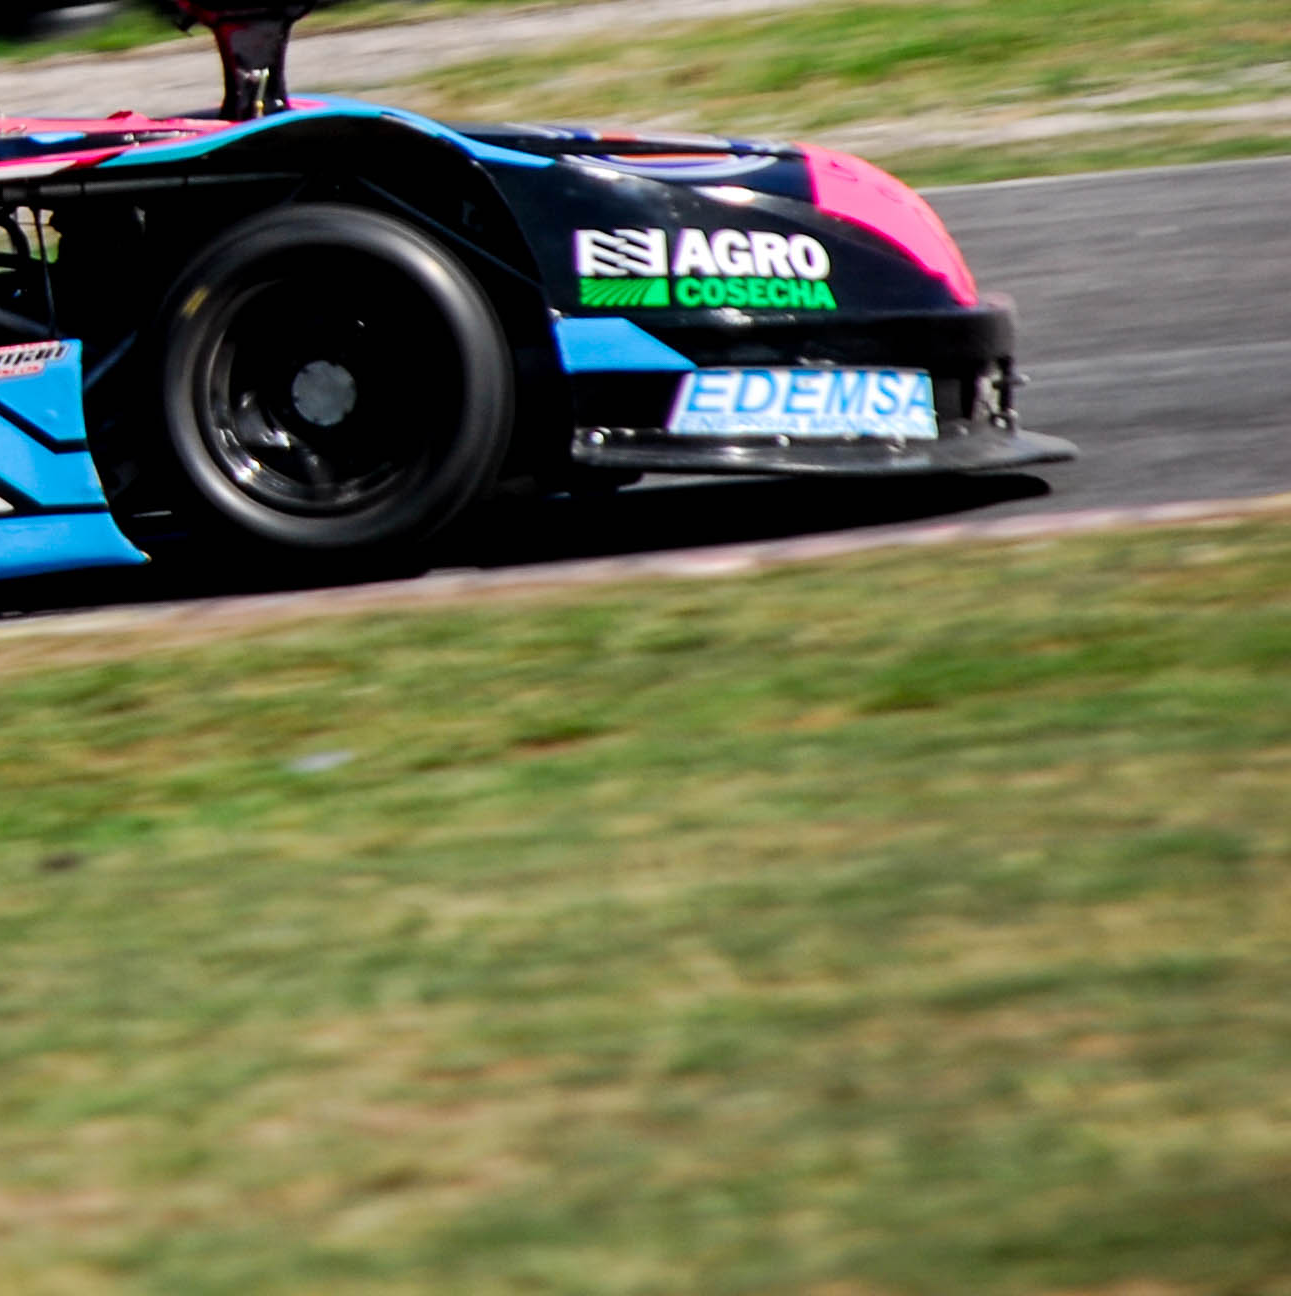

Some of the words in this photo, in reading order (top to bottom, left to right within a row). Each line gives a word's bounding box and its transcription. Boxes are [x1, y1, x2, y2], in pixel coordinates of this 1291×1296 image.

[672, 227, 831, 280] AGRO
[675, 276, 838, 310] COSECHA
[685, 368, 935, 416] EDEMSA
